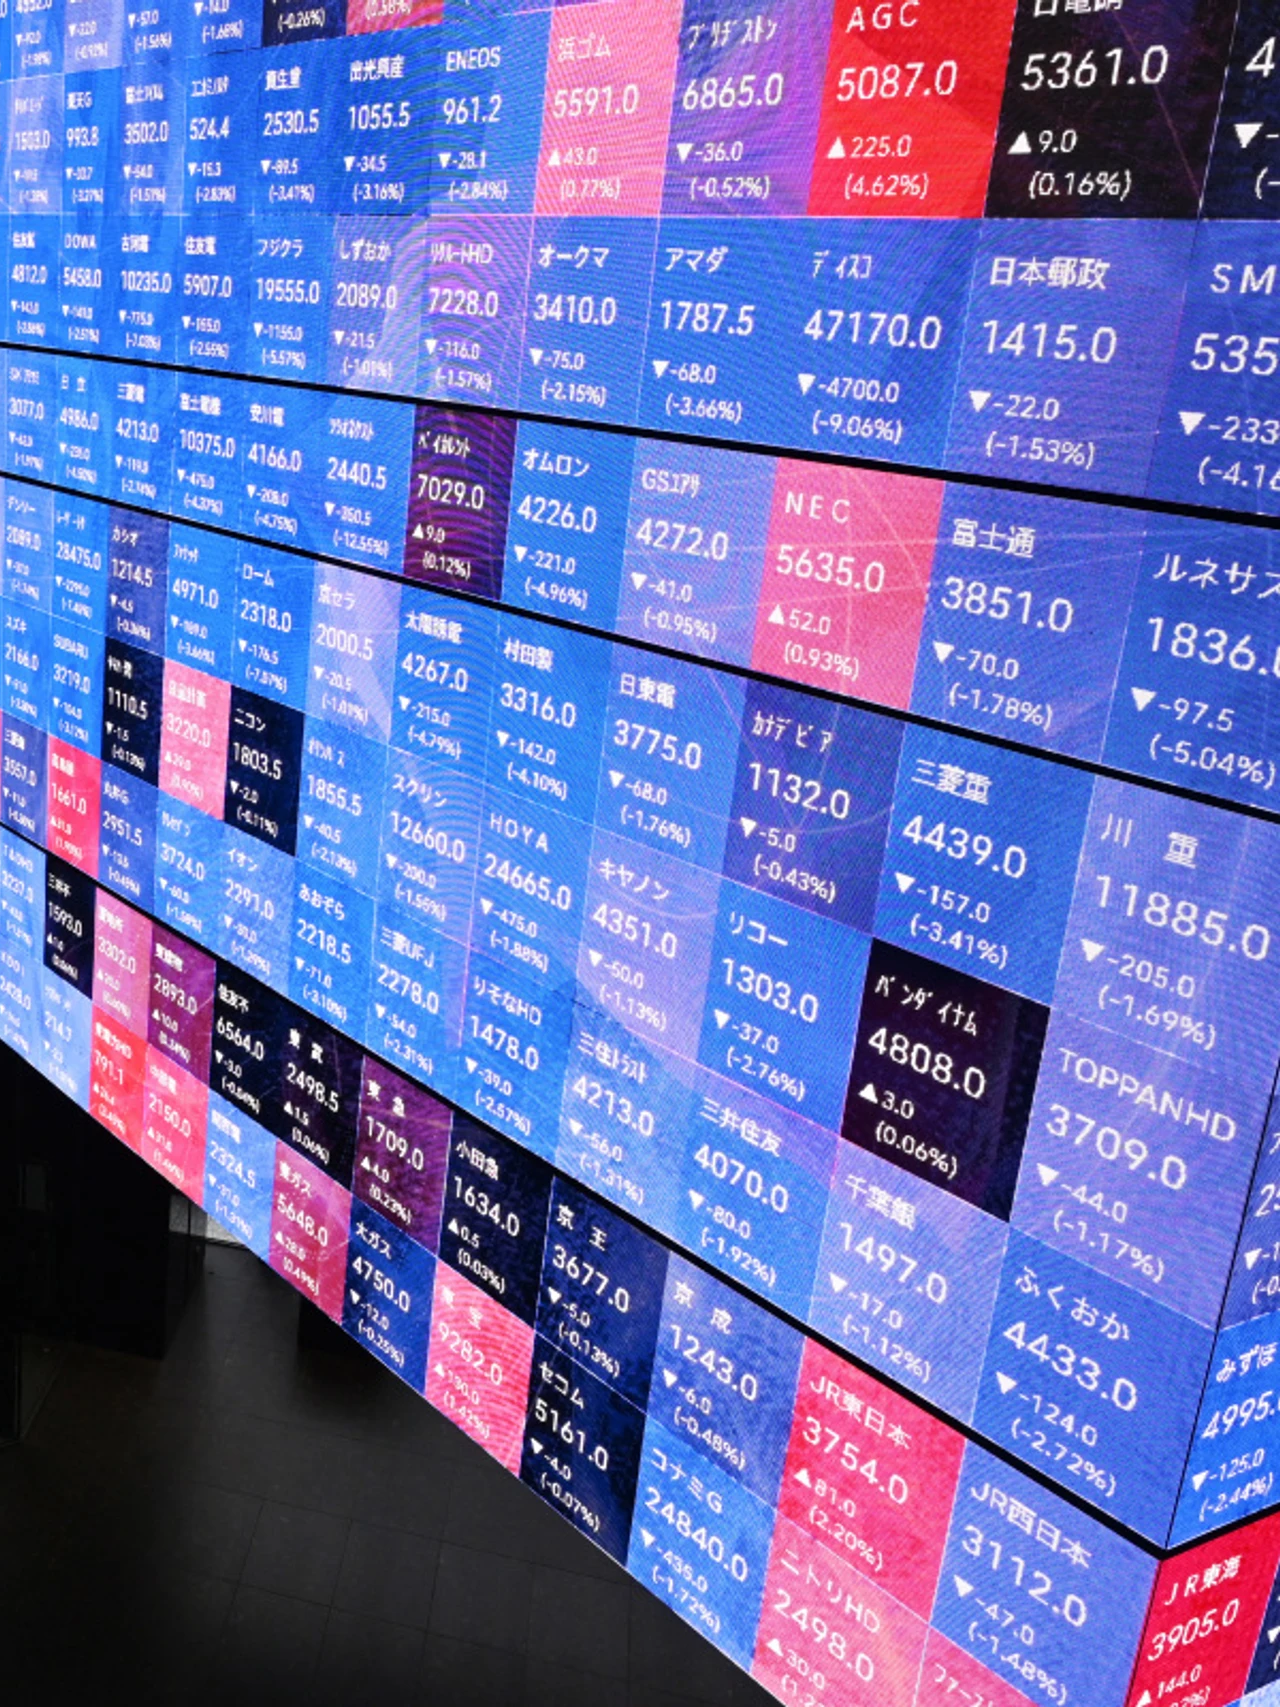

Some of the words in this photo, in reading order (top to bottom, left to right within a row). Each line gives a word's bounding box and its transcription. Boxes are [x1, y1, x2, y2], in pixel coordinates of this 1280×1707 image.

[845, 0, 919, 33] AGC
[350, 55, 405, 82] 出光興産
[446, 47, 501, 72] ENEOS
[1021, 45, 1169, 91] 5361.0
[682, 72, 784, 110] 6865.0
[836, 60, 957, 101] 5087.0
[263, 109, 319, 135] 2530.5
[348, 102, 411, 131] 1055.5
[443, 95, 502, 124] 961.2
[552, 84, 639, 119] 5591.0
[67, 126, 99, 147] 993.8
[124, 121, 168, 144] 3502.0
[190, 116, 230, 140] 524.4
[850, 134, 913, 159] 225.0
[1038, 129, 1077, 153] 9.0
[690, 175, 771, 200] (-0.52%)
[844, 173, 929, 200] (4.62%)
[1028, 169, 1132, 202] (0.16%)
[257, 238, 303, 258] フジクラ
[339, 239, 391, 261] しずおか
[538, 246, 610, 268] オークマ
[666, 246, 729, 273] アマダ
[812, 250, 872, 279] ディスコ
[64, 267, 102, 288] 5458.0
[121, 270, 171, 294] 10235.0
[184, 274, 232, 298] 5907.0
[257, 278, 320, 304] 19555.0
[989, 257, 1110, 290] 日本郵政
[336, 282, 398, 310] 2089.0
[429, 287, 499, 318] 7228.0
[533, 293, 617, 326] 3410.0
[661, 301, 756, 336] 1787.5
[804, 310, 943, 350] 47170.0
[983, 320, 1118, 364] 1415.0
[665, 393, 742, 425] (-3.66%)
[818, 377, 900, 404] -4700.0
[116, 418, 160, 443] 4213.0
[179, 429, 236, 459] 10375.0
[812, 409, 903, 445] (-9.06%)
[248, 442, 302, 472] 4166.0
[523, 447, 590, 478] オムロン
[985, 431, 1095, 470] (-1.53%)
[326, 457, 387, 490] 2440.5
[417, 474, 485, 510] 7029.0
[517, 494, 598, 534] 4226.0
[784, 491, 850, 524] NEC
[635, 518, 730, 561] 4272.0
[952, 518, 1036, 559] 富士通
[112, 558, 153, 588] 1214.5
[243, 564, 274, 587] ローム
[775, 544, 885, 594] 5635.0
[173, 578, 218, 609] 4971.0
[318, 583, 356, 610] 京セラ
[941, 576, 1074, 633] 3851.0
[240, 599, 291, 632] 2318.0
[316, 623, 374, 661] 2000.5
[504, 637, 554, 673] 村田製
[783, 640, 860, 682] (0.93%)
[54, 663, 90, 694] 3219.0
[401, 652, 468, 692] 4267.0
[619, 673, 676, 709] 日東電
[235, 708, 266, 731] ニコン
[500, 683, 576, 728] 3316.0
[949, 682, 1054, 731] (-1.78%)
[1157, 697, 1235, 731] -97.5
[233, 741, 283, 781] 1803.5
[613, 719, 701, 769] 3775.0
[1149, 733, 1276, 790] (-5.04%)
[307, 775, 362, 816] 1855.5
[393, 774, 447, 807] スクリン
[749, 763, 850, 819] 1132.0
[912, 759, 993, 805] 三菱重
[391, 811, 465, 863] 12660.0
[490, 813, 548, 853] HOYA
[902, 815, 1028, 879] 4439.0
[484, 853, 571, 910] 24665.0
[600, 857, 669, 900] キヤノン
[754, 853, 835, 904] (-0.43%)
[299, 883, 345, 921] あおぞら
[1096, 875, 1271, 961] 11885.0
[297, 919, 351, 964] 2218.5
[593, 903, 677, 959] 4351.0
[729, 911, 789, 946] リコー
[910, 913, 1008, 969] (-3.41%)
[153, 974, 198, 1016] 2893.0
[378, 964, 439, 1015] 2278.0
[474, 976, 542, 1026] りそなHD
[723, 957, 819, 1023] 1303.0
[1098, 984, 1217, 1051] (-1.69%)
[217, 1017, 264, 1061] 6564.0
[471, 1016, 540, 1071] 1478.0
[868, 1027, 986, 1099] 4808.0
[286, 1063, 339, 1112] 2498.5
[572, 1075, 654, 1137] 4213.0
[881, 1089, 915, 1119] 3.0
[1059, 1047, 1236, 1143] TOPPANHD
[366, 1115, 424, 1170] 1709.0
[699, 1096, 782, 1157] 三井住友
[1046, 1103, 1187, 1190] 3709.0
[875, 1120, 958, 1180] (0.06%)
[694, 1144, 789, 1213] 4070.0
[277, 1193, 328, 1247] 5648.0
[454, 1176, 519, 1236] 1634.0
[845, 1174, 917, 1231] 千葉銀
[838, 1222, 948, 1304] 1497.0
[1053, 1209, 1165, 1283] (-1.17%)
[352, 1255, 410, 1312] 4750.0
[552, 1244, 629, 1313] 3677.0
[1015, 1265, 1130, 1342] ふくおか
[438, 1322, 503, 1385] 9282.0
[671, 1324, 758, 1402] 1243.0
[1003, 1321, 1137, 1412] 4433.0
[1216, 1342, 1279, 1382] みずほ
[539, 1361, 584, 1409] セコム
[811, 1376, 911, 1449] JR東日本
[534, 1399, 609, 1471] 5161.0
[803, 1416, 909, 1505] 3754.0
[1010, 1418, 1117, 1497] (-2.72%)
[652, 1448, 723, 1514] コナミG
[1199, 1472, 1273, 1522] (-2.44%)
[540, 1472, 600, 1532] (-0.07%)
[645, 1486, 748, 1582] 24840.0
[809, 1504, 883, 1571] (2.20%)
[971, 1482, 1091, 1569] JR西日本
[781, 1549, 880, 1634] ニトリHD
[962, 1525, 1088, 1628] 3112.0
[1164, 1555, 1242, 1606] JR東海
[774, 1589, 874, 1682] 2498.0
[1147, 1599, 1240, 1661] 3905.0
[968, 1621, 1069, 1706] (-1.48%)
